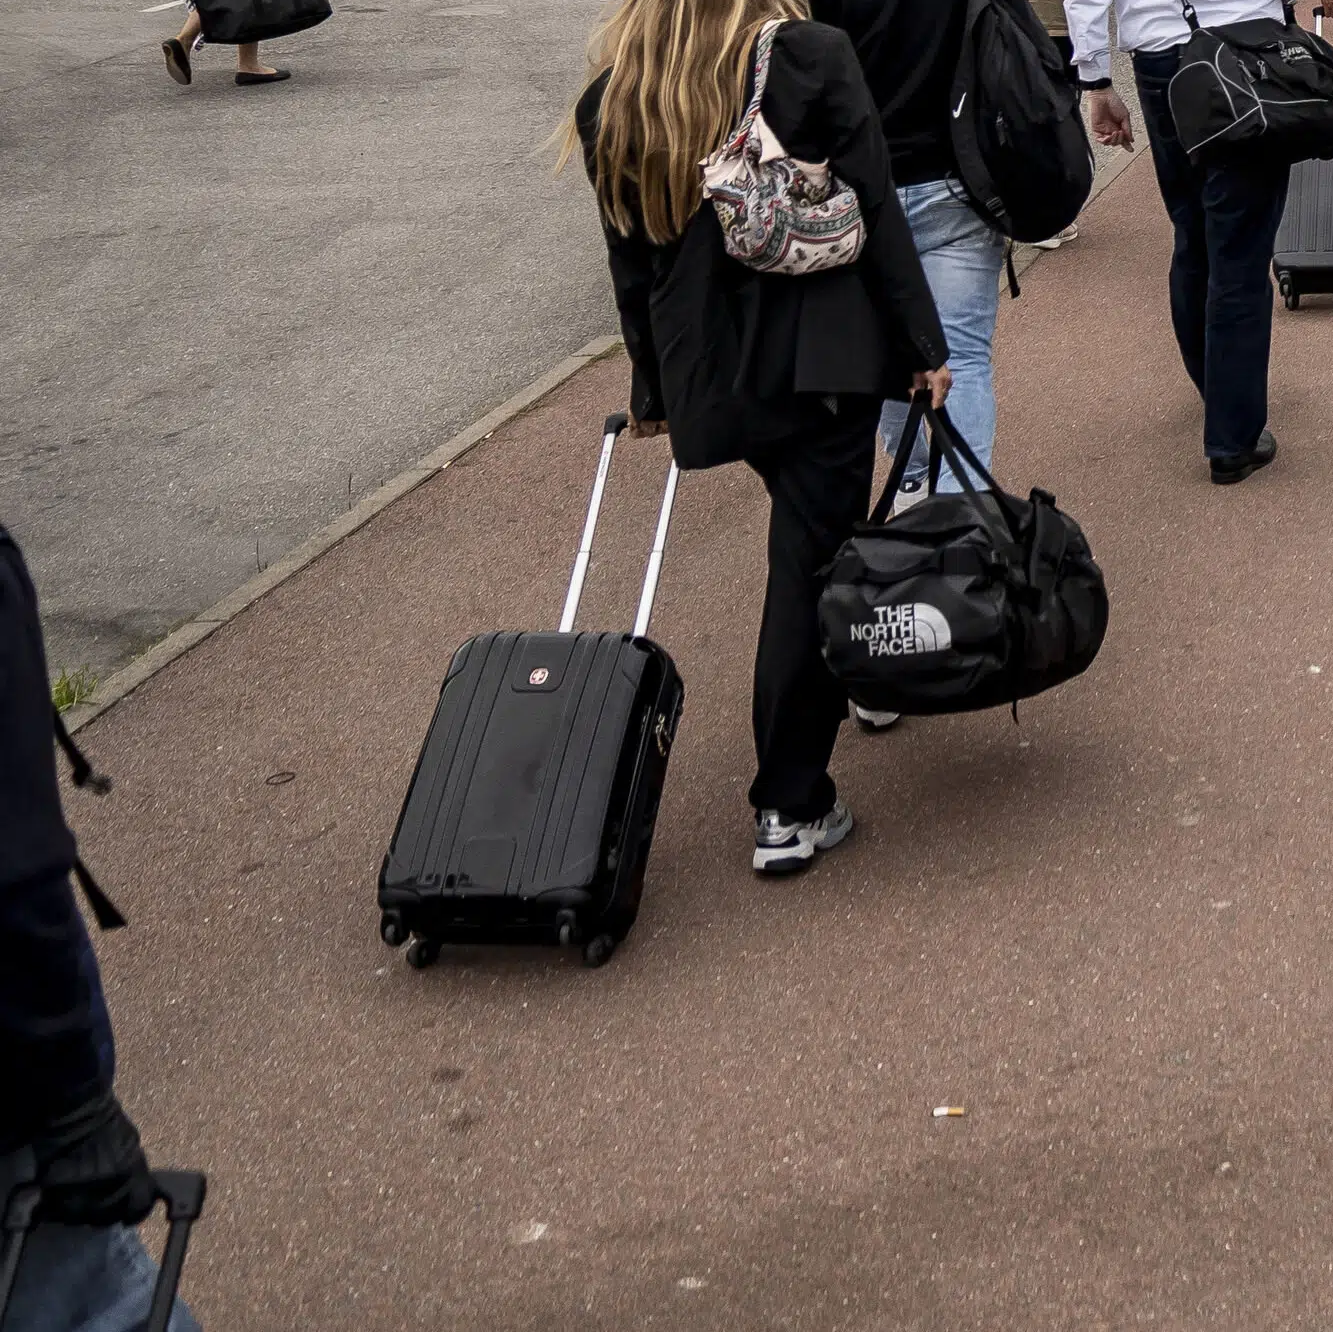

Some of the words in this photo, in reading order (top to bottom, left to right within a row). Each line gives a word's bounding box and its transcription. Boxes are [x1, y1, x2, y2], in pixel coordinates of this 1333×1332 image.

[874, 604, 914, 624] THE
[850, 620, 914, 641] NORTH
[868, 637, 915, 657] FACE
